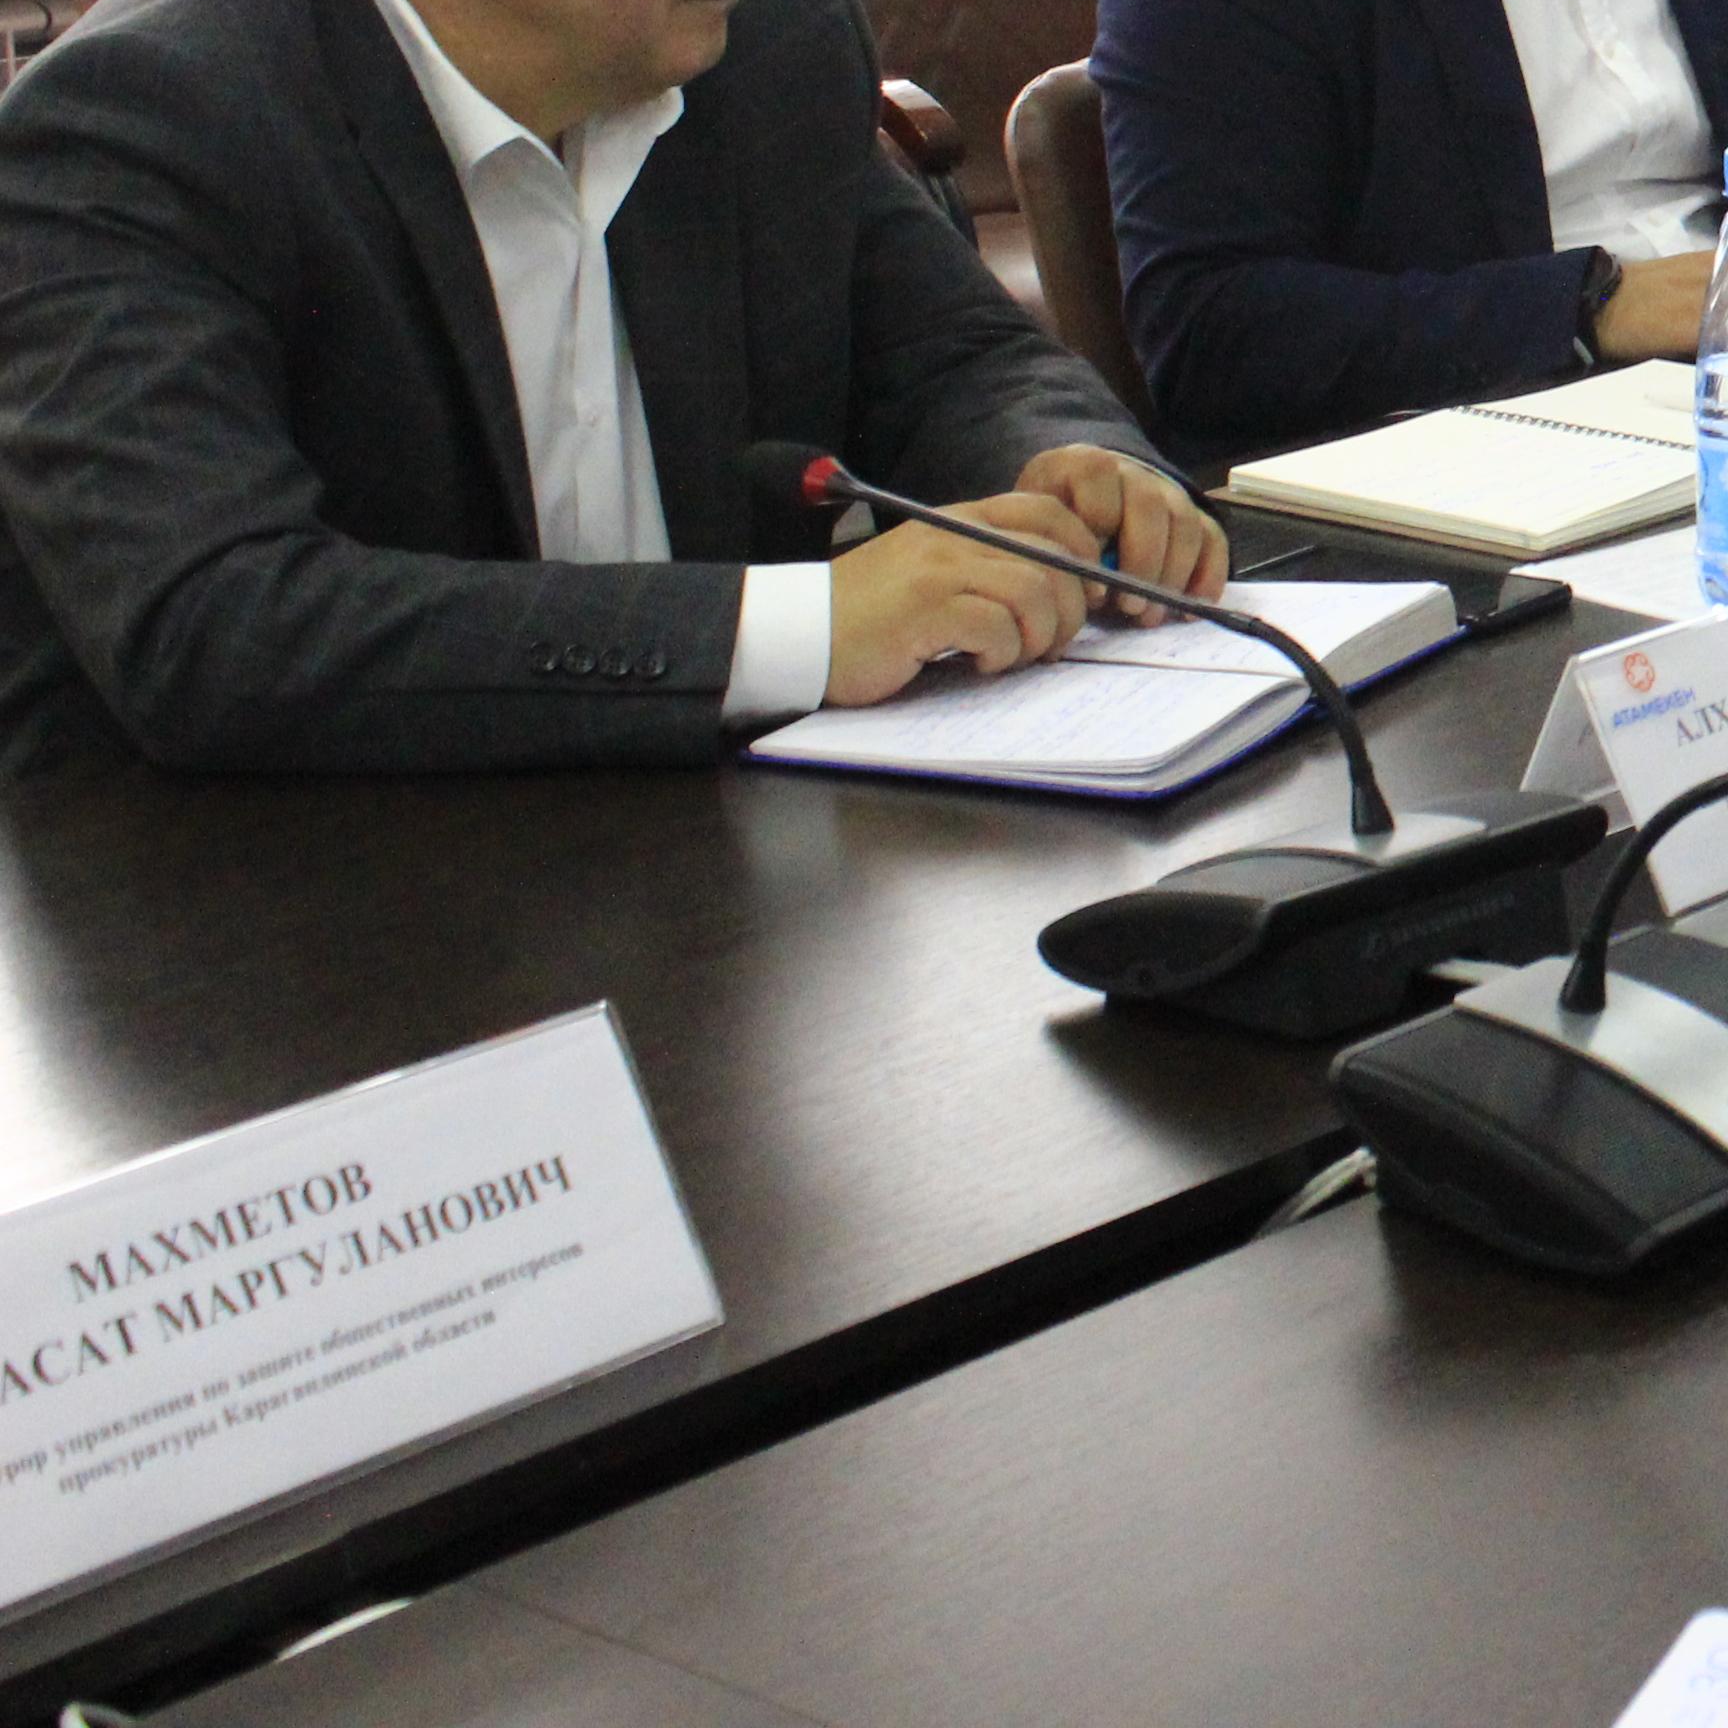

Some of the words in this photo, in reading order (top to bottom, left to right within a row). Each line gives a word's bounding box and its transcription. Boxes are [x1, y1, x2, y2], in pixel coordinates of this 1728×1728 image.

[1611, 687, 1697, 730] АТАМЕКЕН
[0, 1310, 138, 1406] АСАТ
[155, 1153, 574, 1343] МАРГУЛАНОВИЧ
[66, 1161, 374, 1304] МАХМЕТОВ
